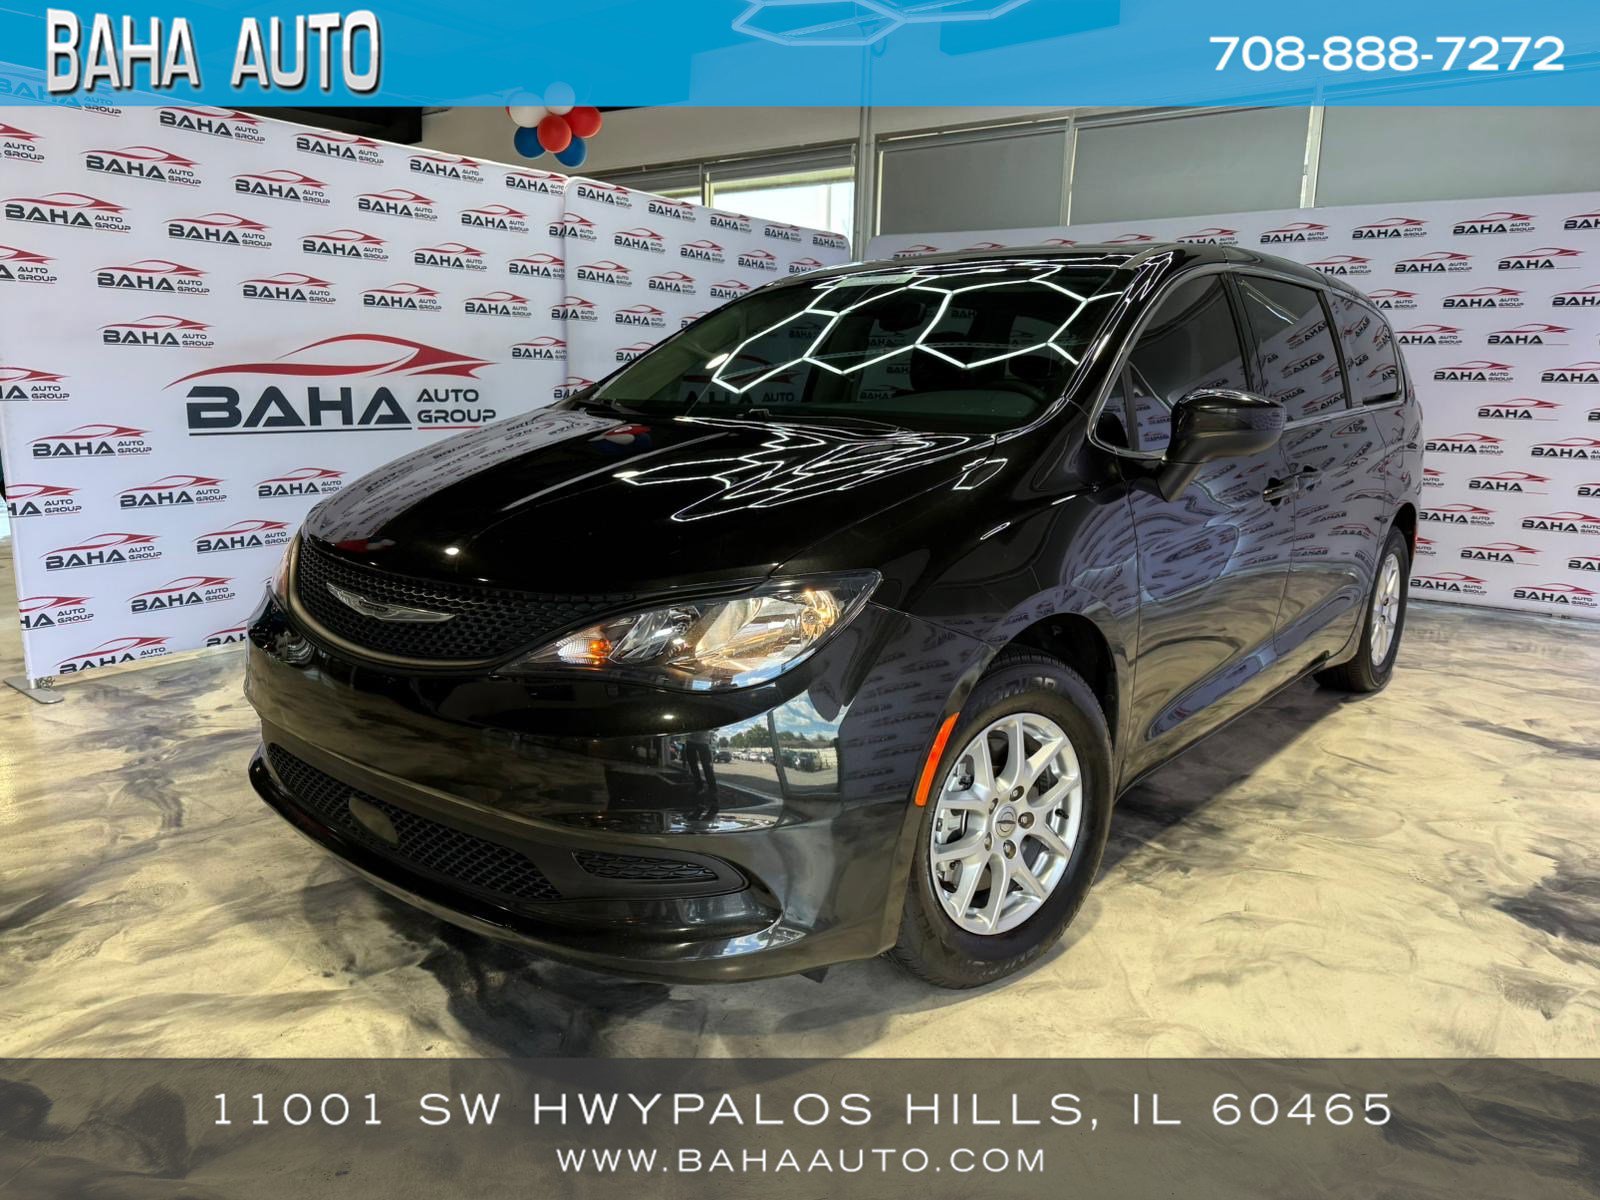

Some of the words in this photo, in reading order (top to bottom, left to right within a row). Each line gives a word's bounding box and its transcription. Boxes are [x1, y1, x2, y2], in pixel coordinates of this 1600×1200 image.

[160, 111, 233, 137] BAHA
[235, 126, 258, 134] AUTO
[235, 133, 265, 142] GROUP
[4, 142, 35, 151] AUTO
[296, 138, 356, 159] BAHA
[4, 150, 44, 160] GROUP
[86, 155, 166, 180] BAHA
[168, 168, 193, 176] AUTO
[410, 160, 460, 178] BAHA
[168, 176, 201, 185] GROUP
[506, 176, 549, 192] BAHA
[235, 179, 301, 200] BAHA
[578, 187, 614, 204] BAHA
[358, 198, 413, 216] BAHA
[648, 203, 680, 218] BAHA
[5, 204, 92, 226] BAHA
[95, 222, 131, 231] GROUP
[462, 214, 508, 229] BAHA
[710, 216, 738, 230] BAHA
[168, 224, 240, 243] BAHA
[765, 228, 790, 239] BAHA
[1352, 227, 1402, 239] BAHA
[1453, 224, 1507, 235] BAHA
[614, 237, 649, 250] BAHA
[1260, 233, 1305, 243] BAHA
[303, 240, 362, 256] BAHA
[680, 248, 710, 260] BAHA
[414, 253, 464, 268] BAHA
[738, 257, 764, 269] BAHA
[1498, 259, 1555, 270] BAHA
[509, 264, 552, 277] BAHA
[1395, 262, 1446, 273] BAHA
[97, 273, 176, 290] BAHA
[577, 269, 614, 283] BAHA
[648, 280, 681, 292] BAHA
[243, 285, 307, 300] BAHA
[710, 288, 738, 298] BAHA
[364, 294, 417, 308] BAHA
[1443, 298, 1496, 308] BAHA
[465, 303, 510, 315] BAHA
[616, 313, 650, 325] BAHA
[103, 330, 180, 344] BAHA
[1488, 334, 1543, 344] BAHA
[512, 348, 553, 359] BAHA
[1434, 371, 1486, 381] BAHA
[1541, 373, 1600, 384] BAHA
[416, 389, 478, 402] AUTO
[762, 393, 794, 402] AUTO
[186, 386, 412, 429] BAHA
[418, 409, 496, 423] GROUP
[1478, 409, 1532, 419] BAHA
[33, 441, 114, 456] BAHA
[1425, 442, 1477, 453] BAHA
[1531, 447, 1588, 458] BAHA
[258, 482, 319, 496] BAHA
[1469, 480, 1522, 492] BAHA
[120, 491, 194, 507] BAHA
[1419, 512, 1468, 523] BAHA
[1522, 520, 1578, 532] BAHA
[197, 535, 262, 552] BAHA
[46, 550, 126, 569] BAHA
[128, 552, 162, 560] GROUP
[1461, 550, 1514, 562] BAHA
[1410, 579, 1461, 591] BAHA
[132, 592, 203, 612] BAHA
[1514, 590, 1569, 604] BAHA
[57, 608, 85, 616] AUTO
[57, 614, 94, 623] GROUP
[140, 647, 166, 655] AUTO
